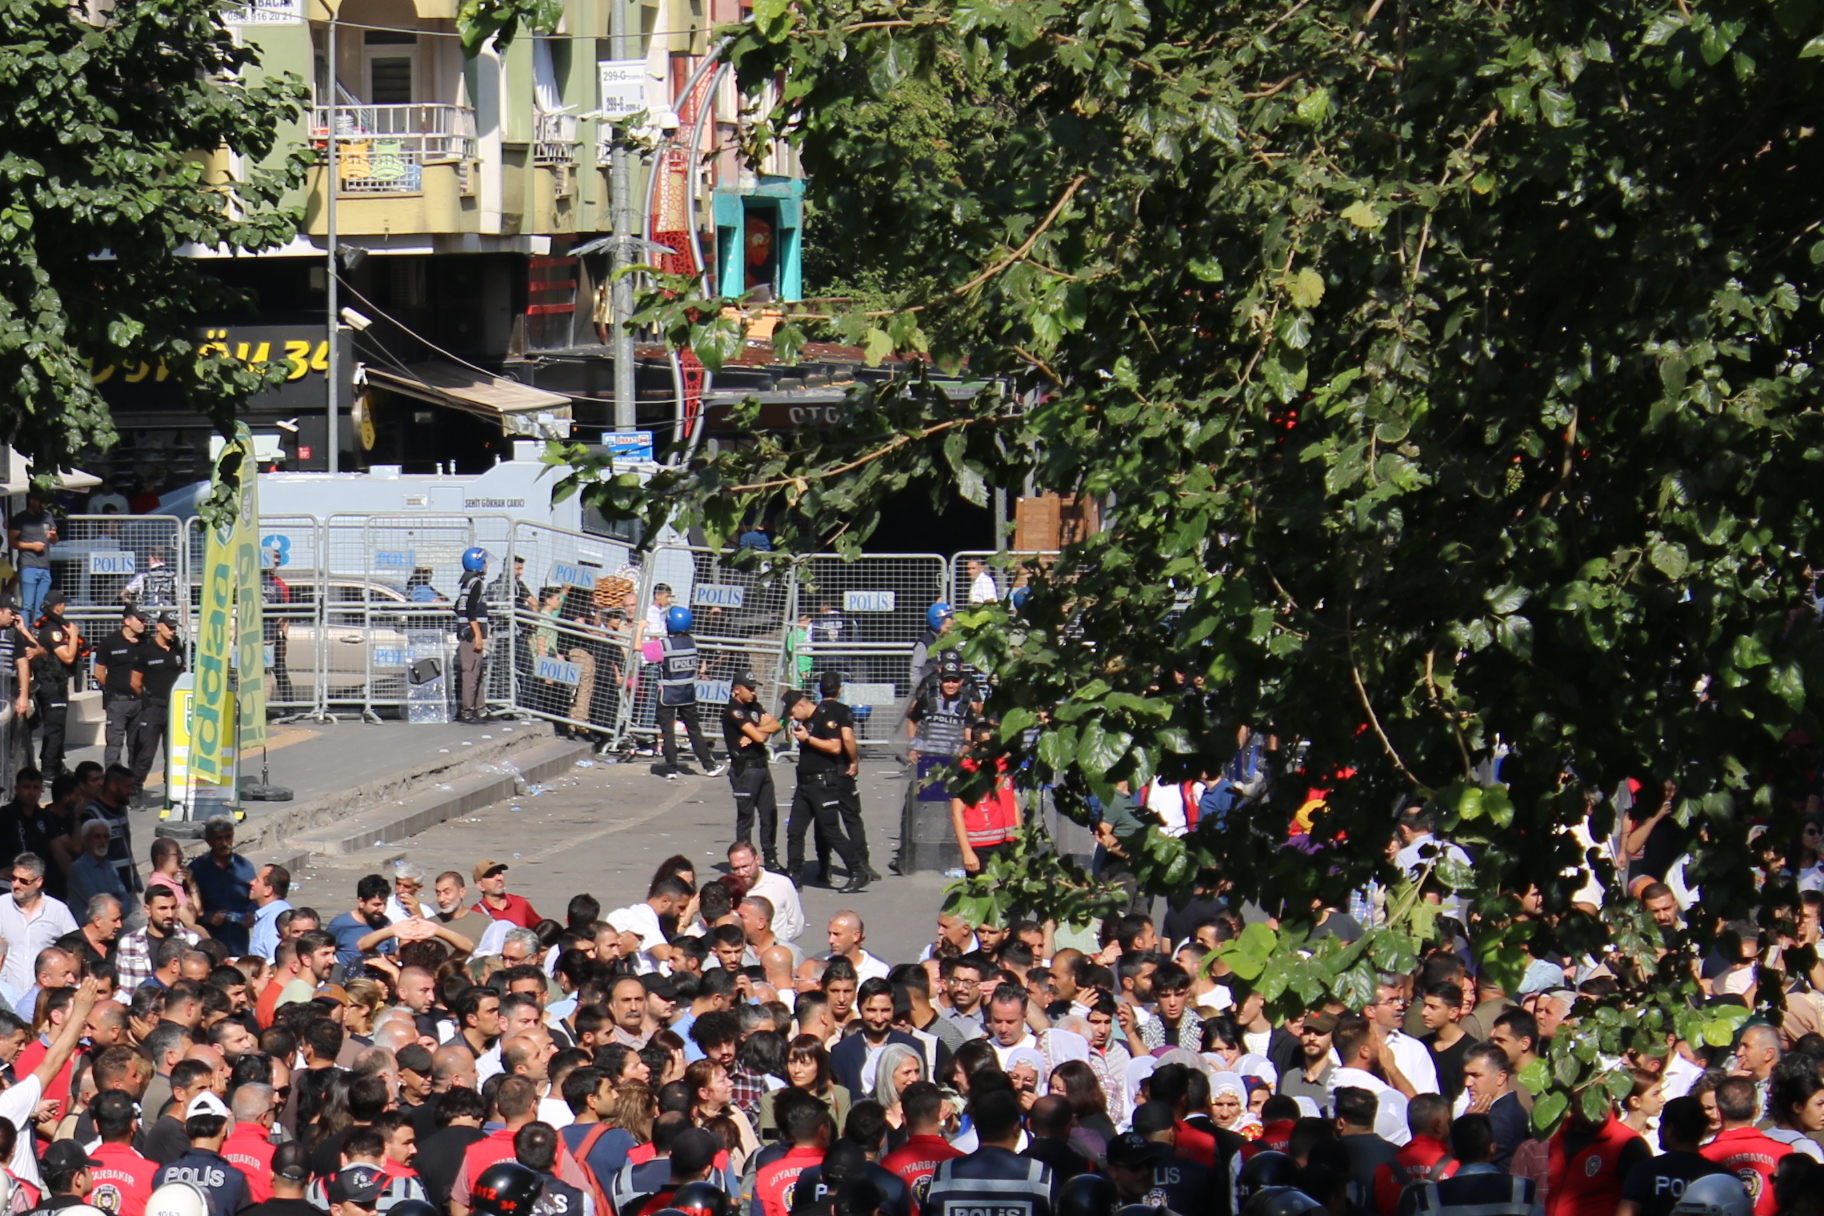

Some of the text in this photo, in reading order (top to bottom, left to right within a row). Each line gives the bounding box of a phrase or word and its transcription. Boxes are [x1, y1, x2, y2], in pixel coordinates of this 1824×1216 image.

[482, 499, 505, 508] GÖKHAN
[93, 553, 134, 573] POLİS
[556, 562, 595, 589] POLİS
[697, 585, 740, 605] POLİS
[848, 591, 889, 610] POLİS
[539, 657, 580, 684] POLİS
[164, 1164, 226, 1188] POLİS
[500, 1199, 516, 1212] 34
